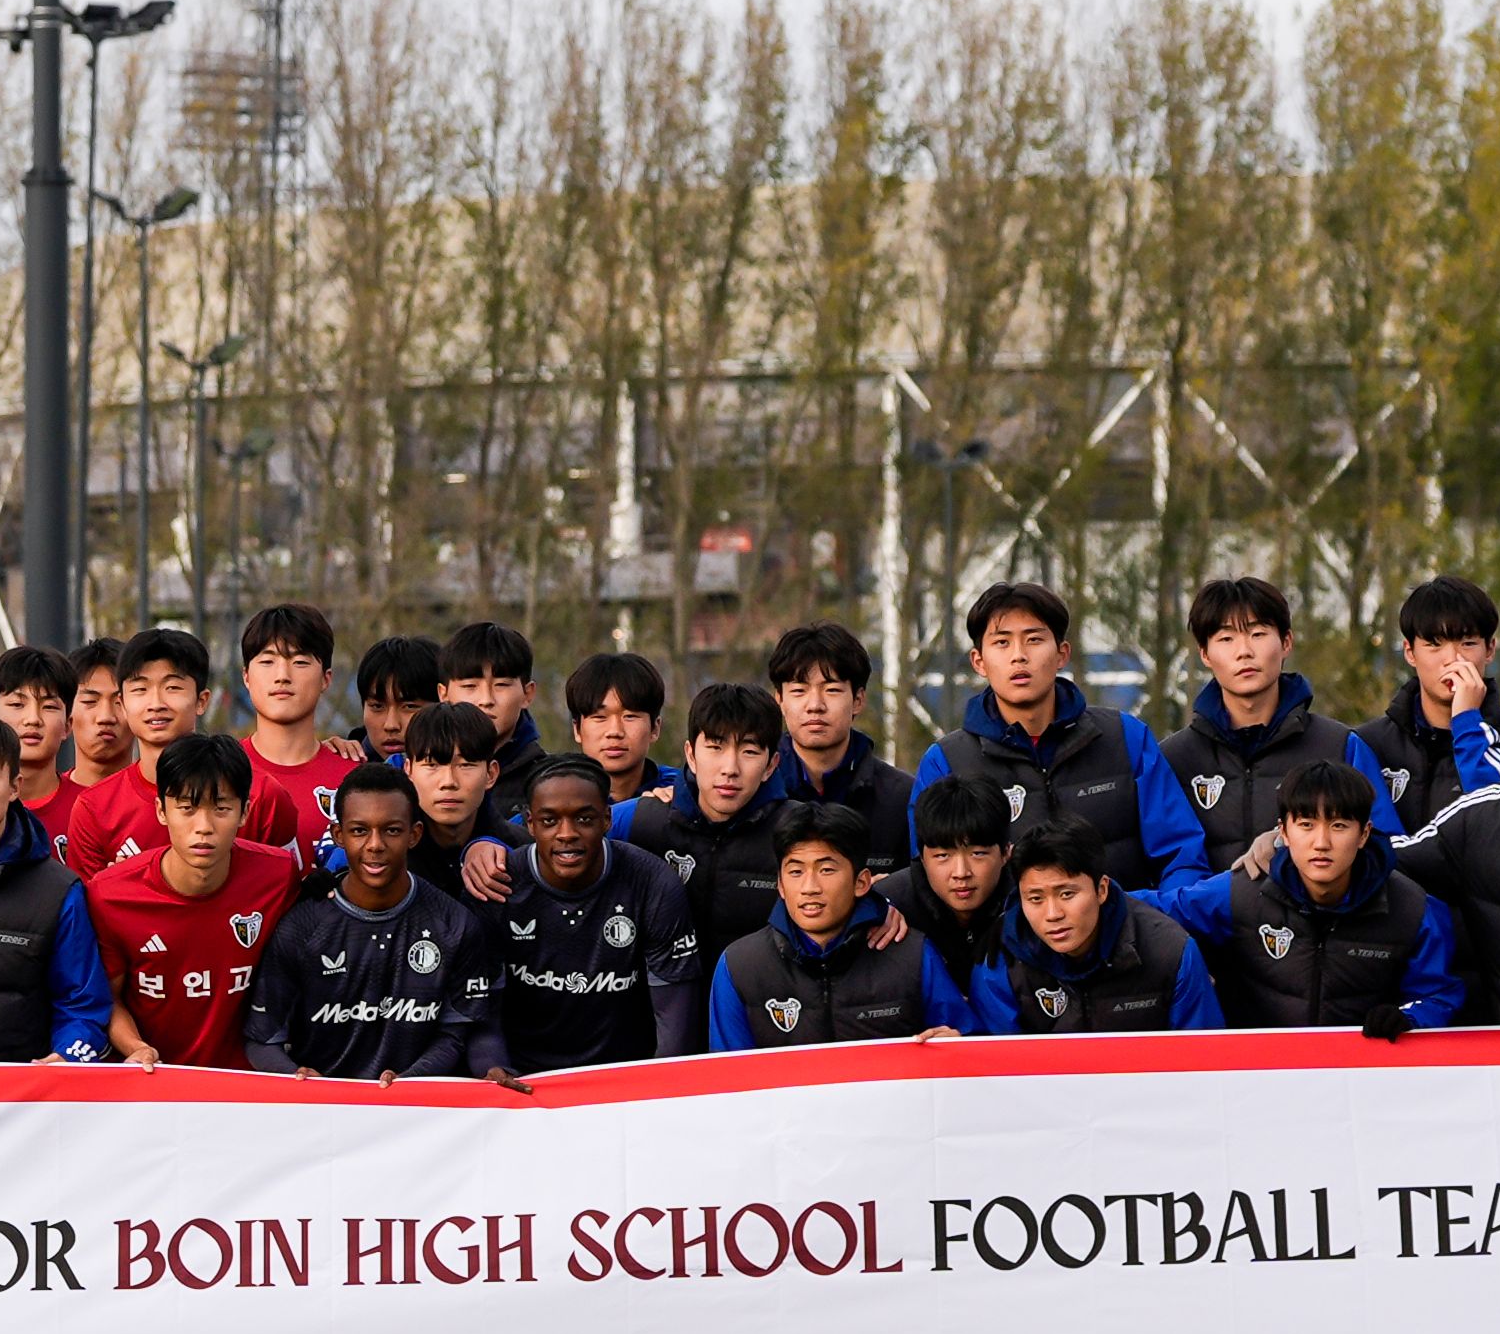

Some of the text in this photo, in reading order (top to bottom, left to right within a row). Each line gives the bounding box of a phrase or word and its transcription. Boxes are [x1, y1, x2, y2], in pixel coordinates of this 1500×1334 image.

[138, 964, 253, 999] 보인고
[311, 1000, 379, 1024] Media
[113, 1217, 312, 1290] BOIN
[343, 1213, 538, 1286] HIGH
[567, 1200, 903, 1282] SCHOOL
[929, 1186, 1357, 1272] FOOTBALL
